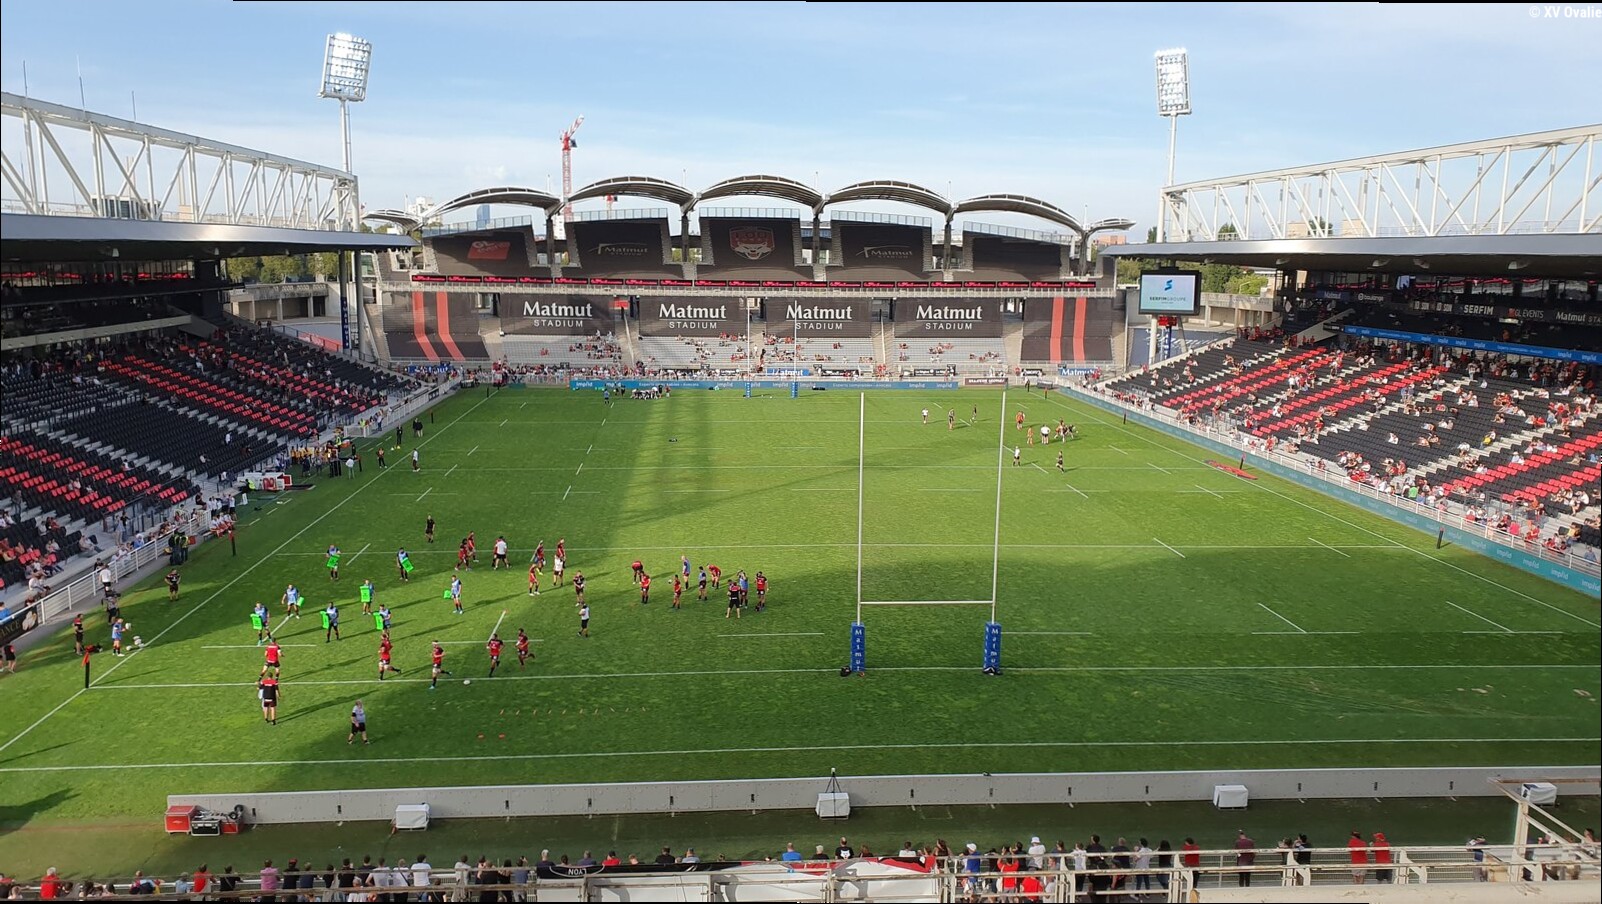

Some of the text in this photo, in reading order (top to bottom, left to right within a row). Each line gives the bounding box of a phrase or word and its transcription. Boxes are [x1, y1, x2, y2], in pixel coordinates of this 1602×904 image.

[523, 301, 593, 317] Matmut
[659, 303, 727, 319] Matmut
[786, 304, 852, 320] Matmut
[916, 304, 983, 320] Matmut
[1463, 304, 1494, 315] SERFIM
[1522, 309, 1544, 319] EVENTS
[1555, 311, 1586, 322] Matmut
[533, 319, 583, 328] STADIUM
[669, 321, 717, 329] STADIUM
[795, 322, 842, 330] STADIUM
[925, 322, 972, 330] STADIUM
[1551, 568, 1569, 580] implid
[568, 868, 587, 876] LYON
